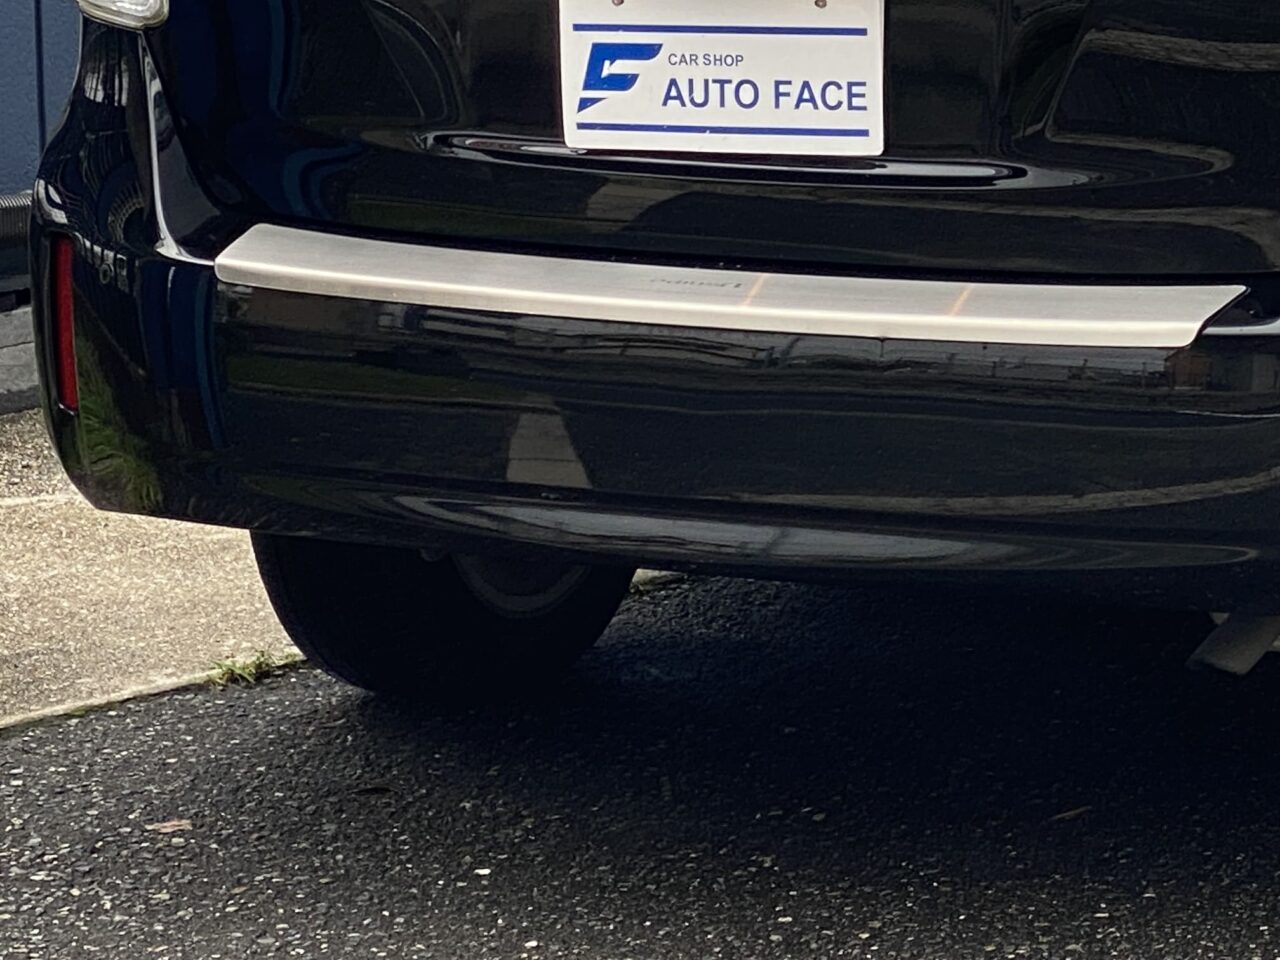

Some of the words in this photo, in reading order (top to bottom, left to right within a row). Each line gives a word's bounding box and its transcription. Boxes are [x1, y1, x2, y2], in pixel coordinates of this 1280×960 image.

[667, 53, 699, 67] CAR
[702, 53, 744, 67] SHOP
[661, 77, 760, 111] AUTO
[773, 80, 868, 112] FACE
